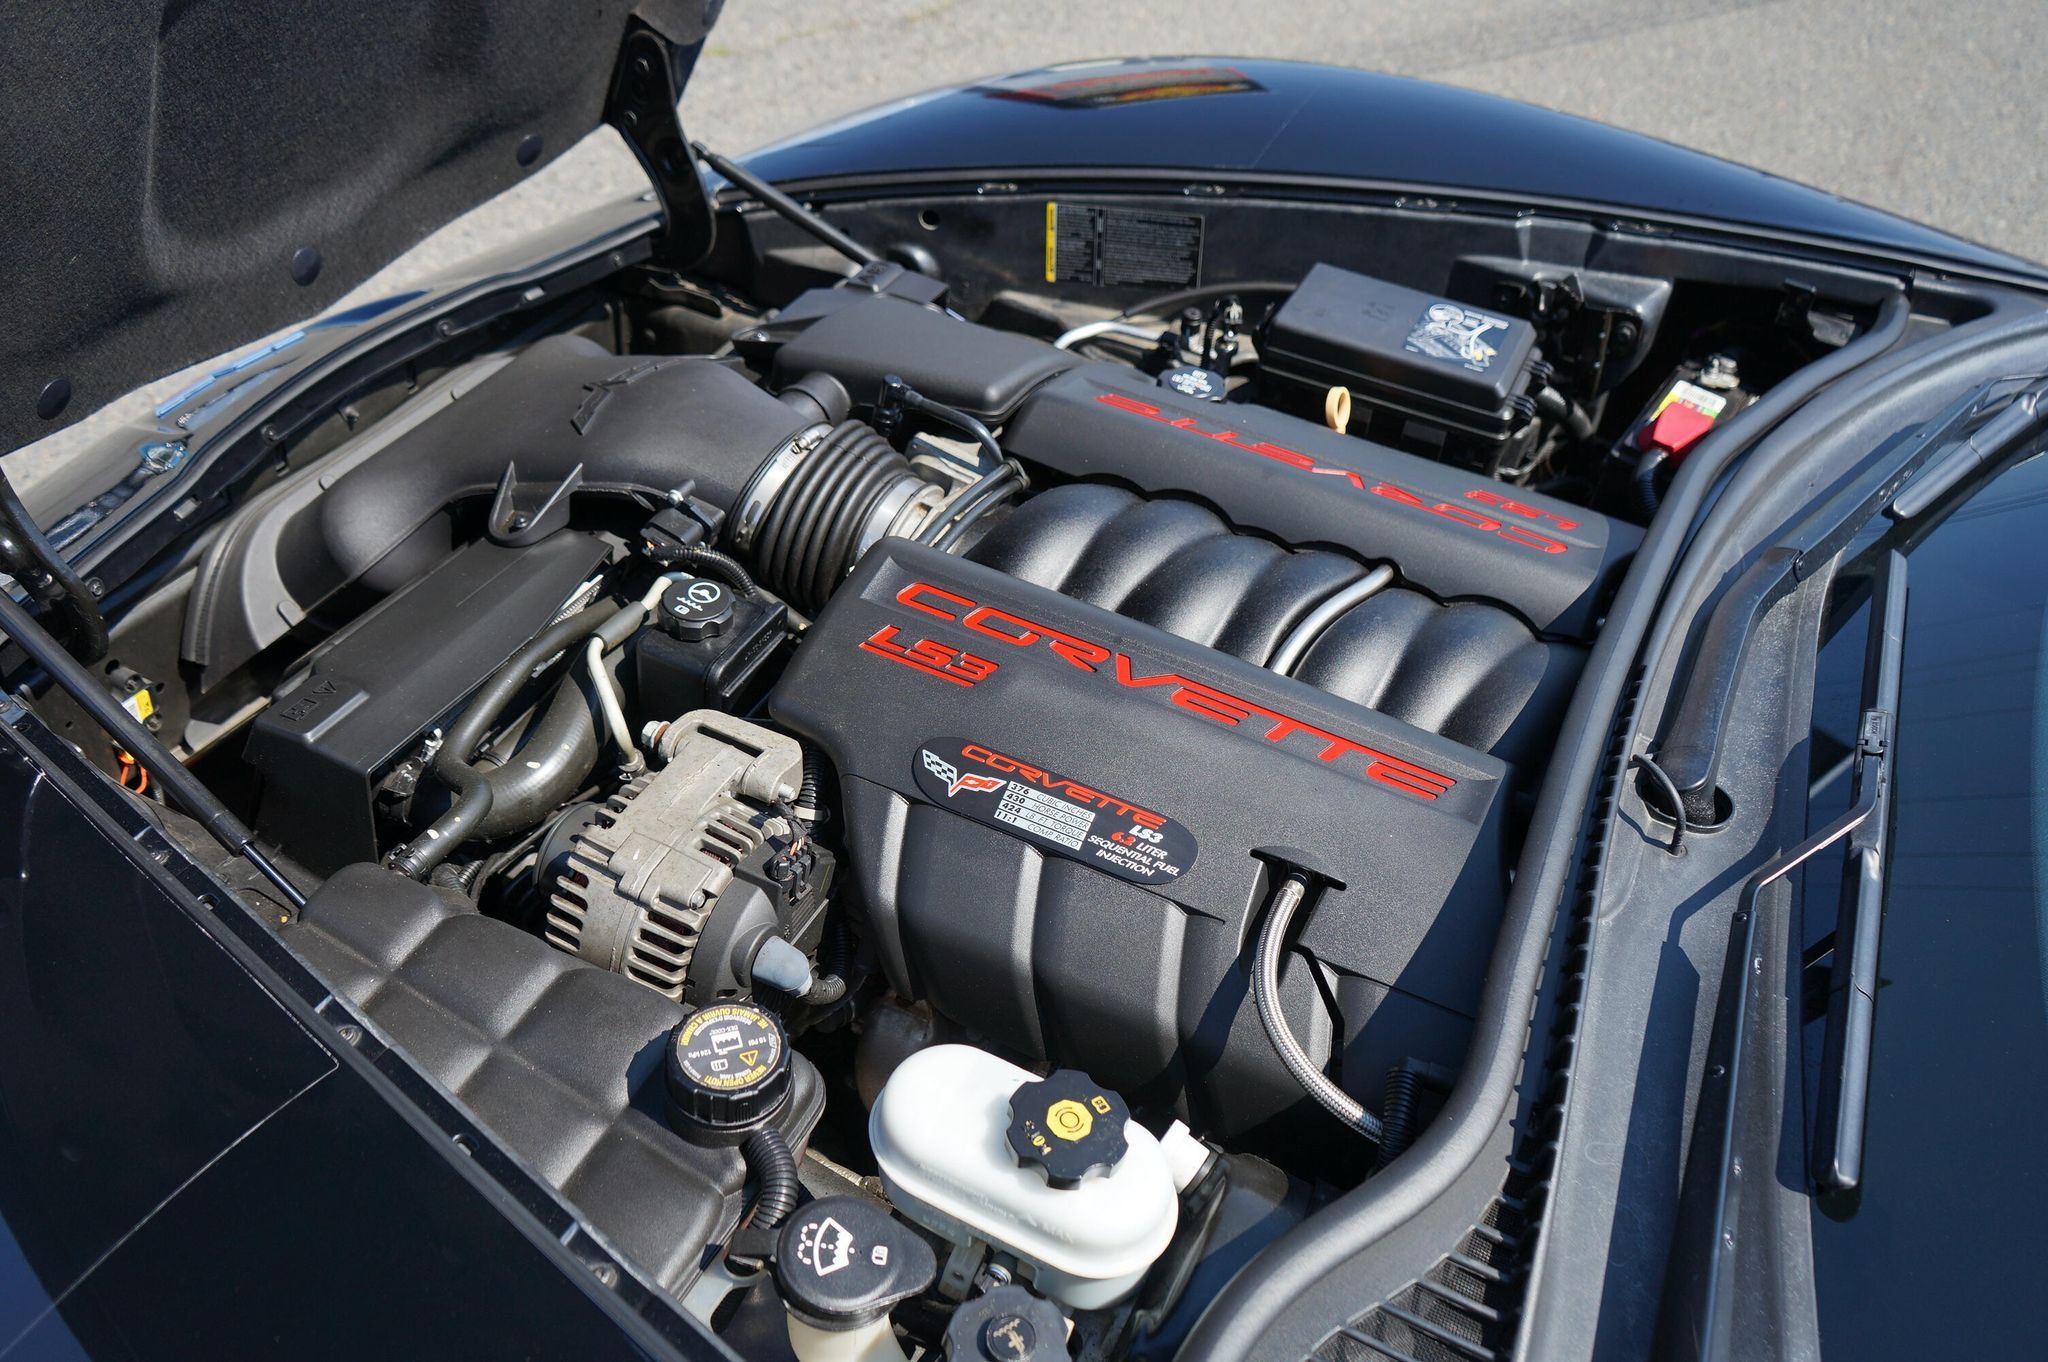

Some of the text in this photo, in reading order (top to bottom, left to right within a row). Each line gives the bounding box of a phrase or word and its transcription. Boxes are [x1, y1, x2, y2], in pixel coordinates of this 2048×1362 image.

[1094, 393, 1568, 553] CORVETTE
[1464, 489, 1580, 531] LS3
[859, 624, 1000, 688] LS3
[896, 581, 1458, 801] CORVETTE
[961, 744, 1167, 830] CORVETTE
[1010, 783, 1093, 820] 376 CUBIC INCHES
[996, 811, 1018, 823] 11:1
[1054, 834, 1079, 848] RATIO
[1002, 802, 1022, 814] 424
[1050, 820, 1084, 839] TORQUE
[1006, 793, 1090, 829] 430 HORSE POWER
[1110, 831, 1168, 860] 6.2 LITER
[1128, 824, 1164, 843] LS3
[1087, 834, 1180, 876] SEQUENTIAL FUEL
[1095, 848, 1156, 876] INJECTION
[731, 1008, 759, 1022] JAMAIS
[723, 1077, 745, 1087] OPEN
